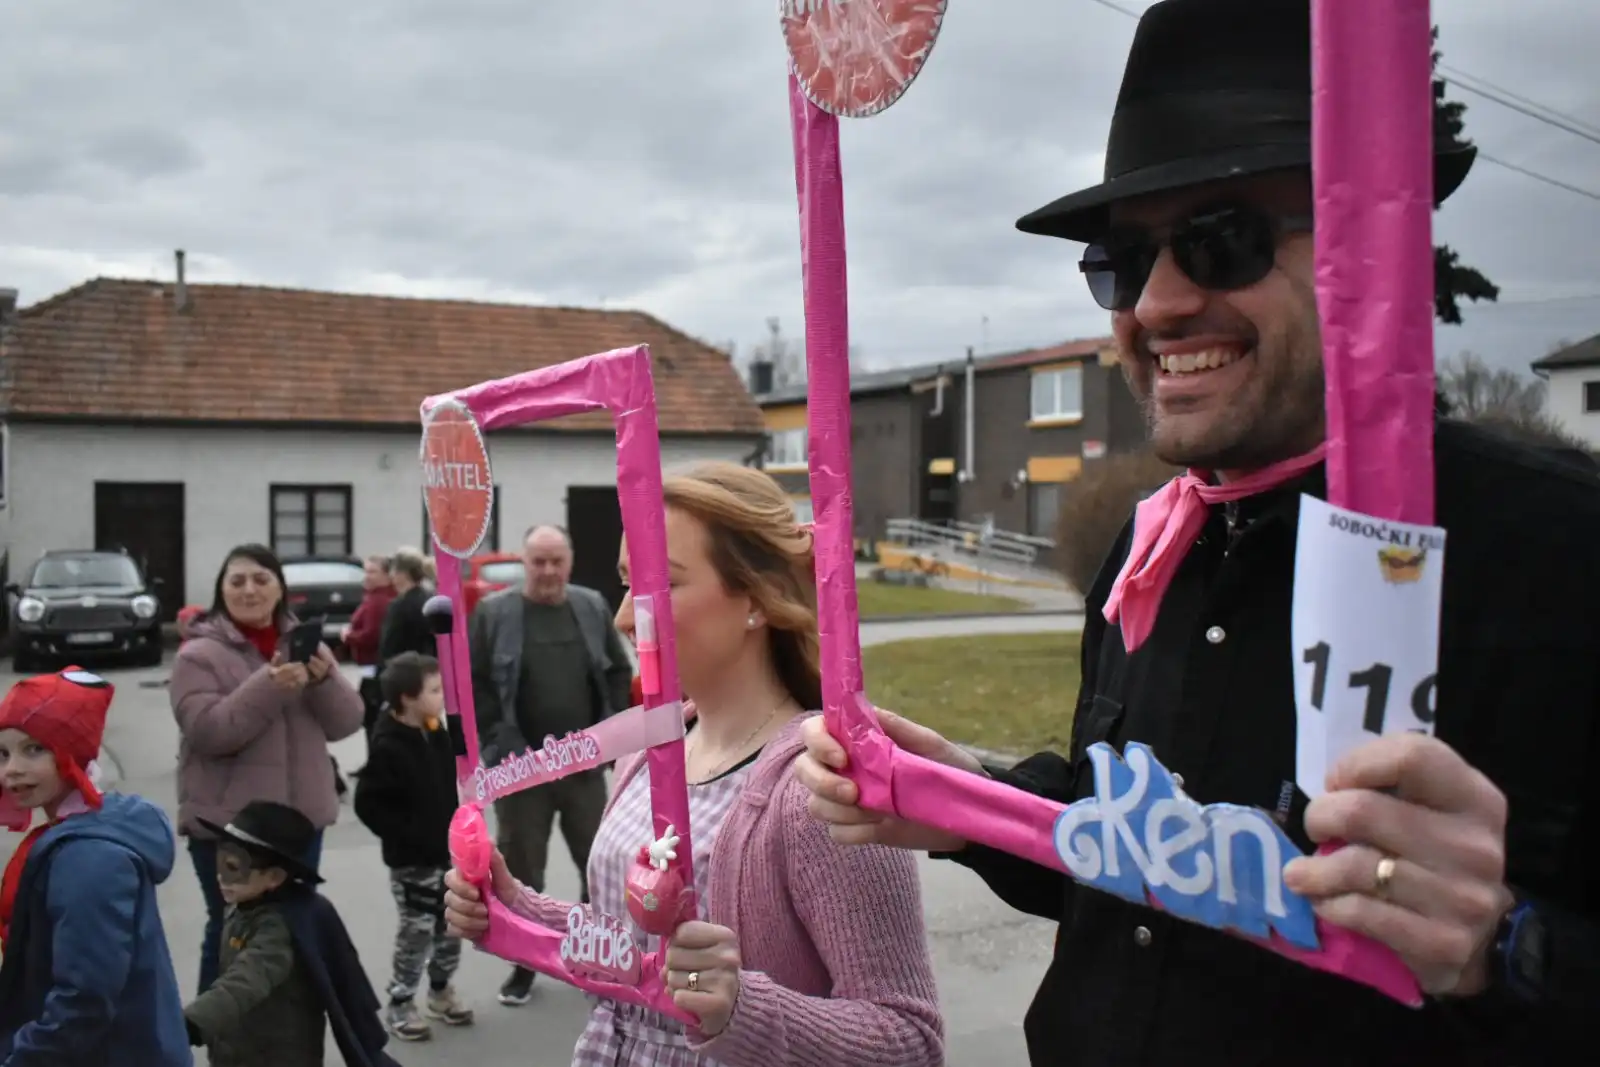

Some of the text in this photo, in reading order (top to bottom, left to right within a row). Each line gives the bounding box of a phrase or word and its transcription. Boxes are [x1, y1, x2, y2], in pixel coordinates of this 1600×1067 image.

[423, 462, 486, 490] MATTEL
[542, 732, 599, 773] Barbie
[1055, 746, 1287, 918] Ken
[560, 904, 634, 972] Barbie
